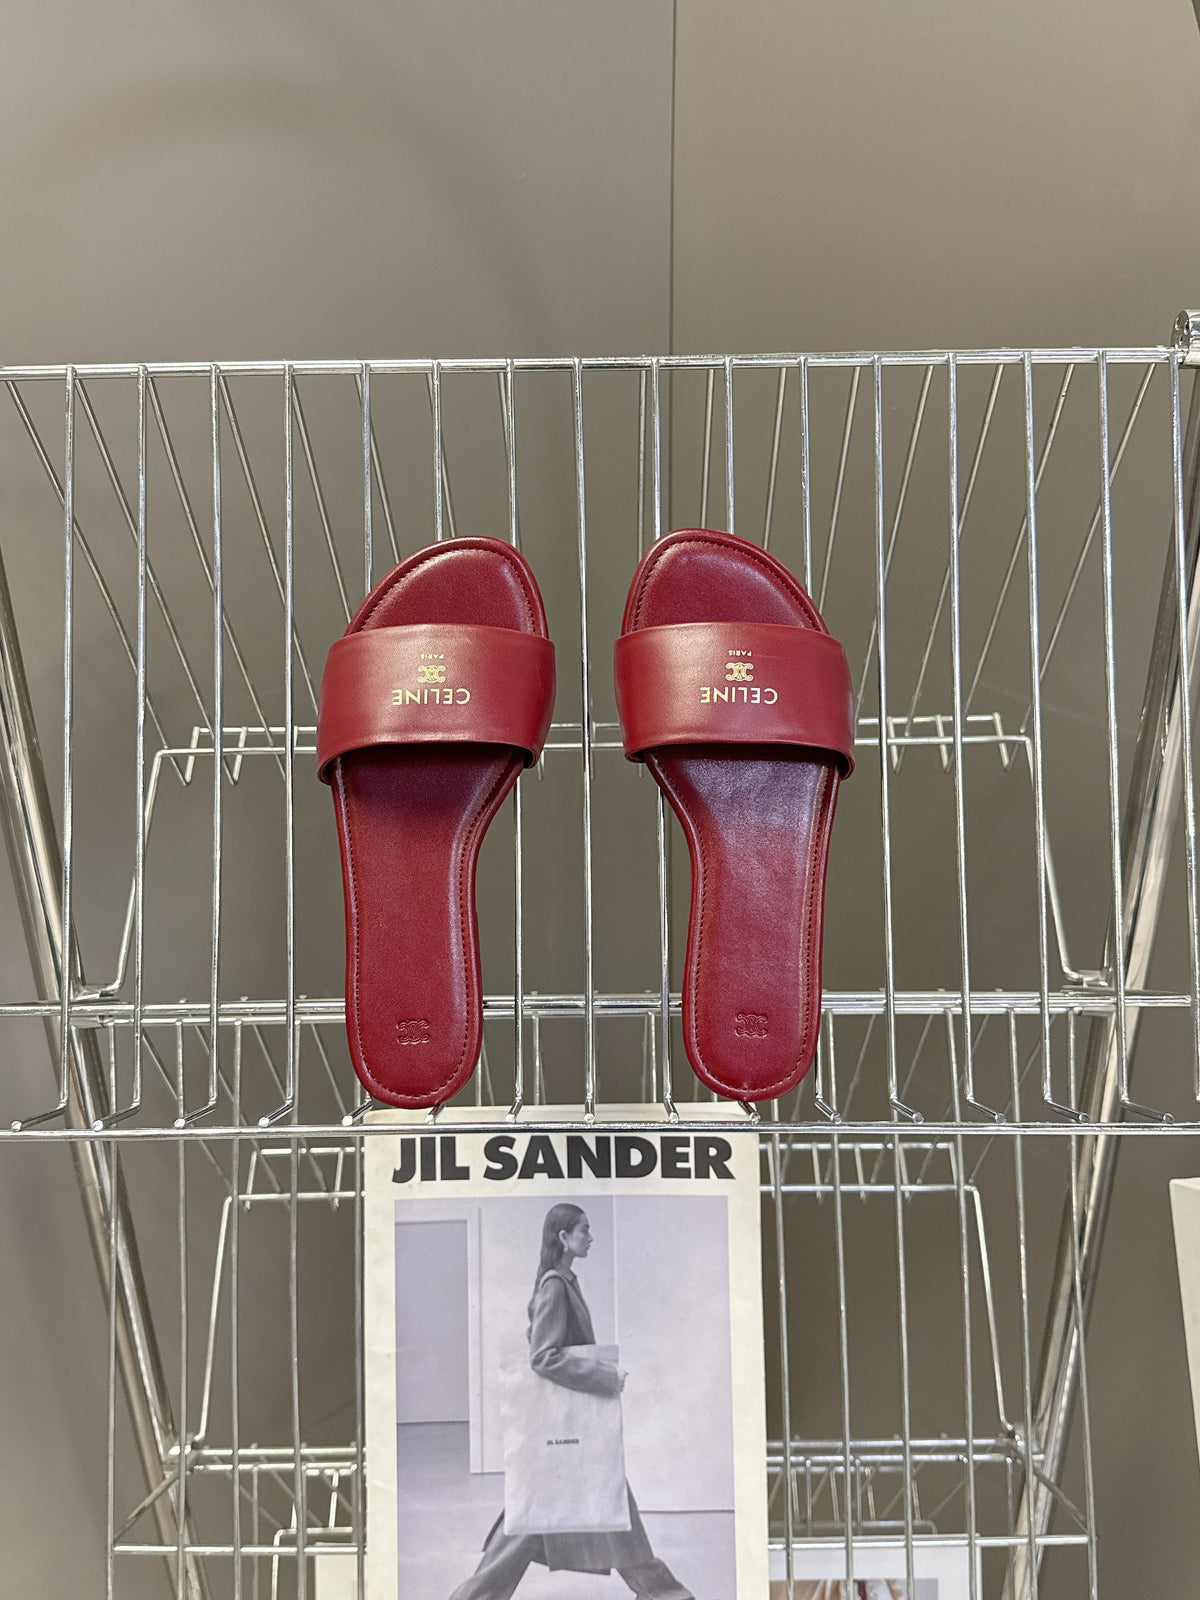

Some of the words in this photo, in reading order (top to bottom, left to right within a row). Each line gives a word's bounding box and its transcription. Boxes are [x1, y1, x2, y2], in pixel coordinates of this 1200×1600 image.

[392, 688, 471, 706] CELINE
[700, 687, 778, 705] CELINE
[392, 1136, 470, 1184] JIL
[483, 1135, 736, 1181] SANDER
